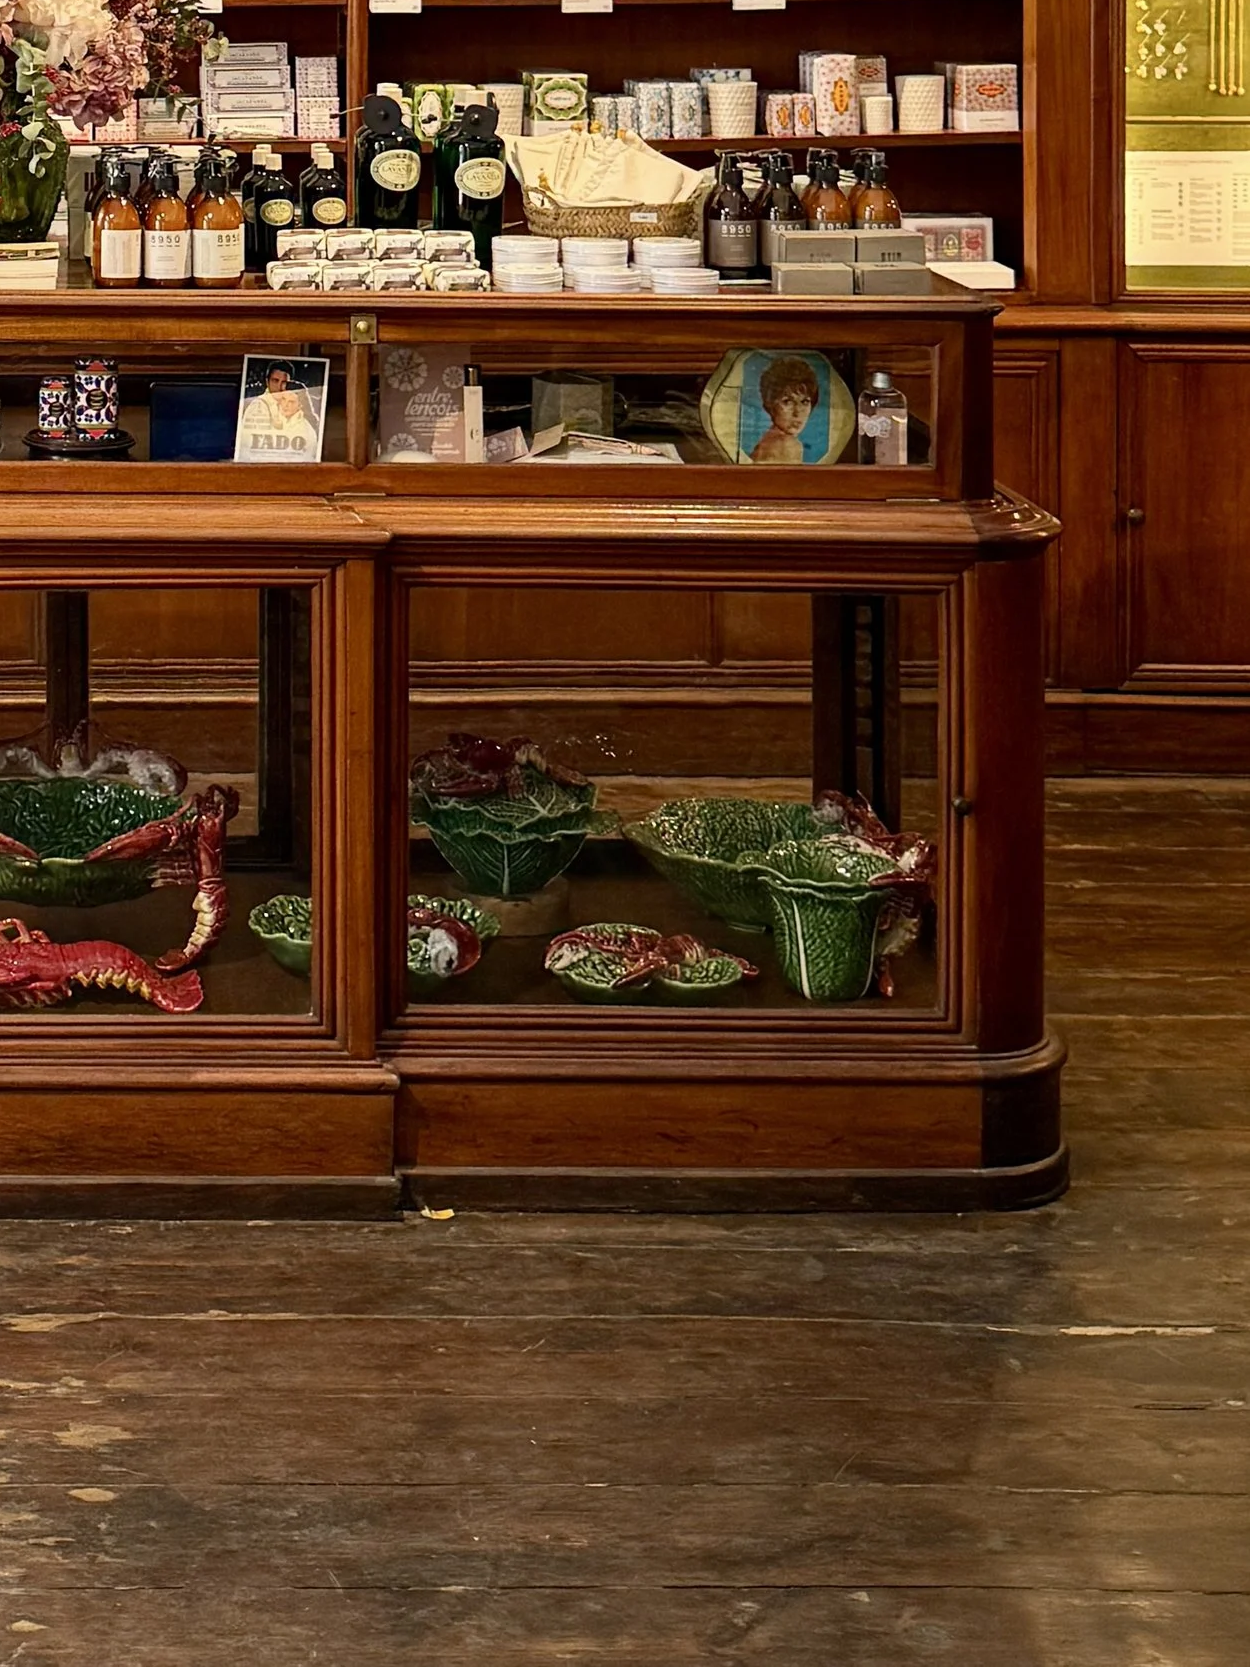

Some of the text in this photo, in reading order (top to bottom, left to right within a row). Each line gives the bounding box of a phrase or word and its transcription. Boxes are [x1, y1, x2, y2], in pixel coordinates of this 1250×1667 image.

[722, 224, 751, 234] 8950
[150, 235, 180, 243] 8950
[251, 433, 307, 451] FADO
